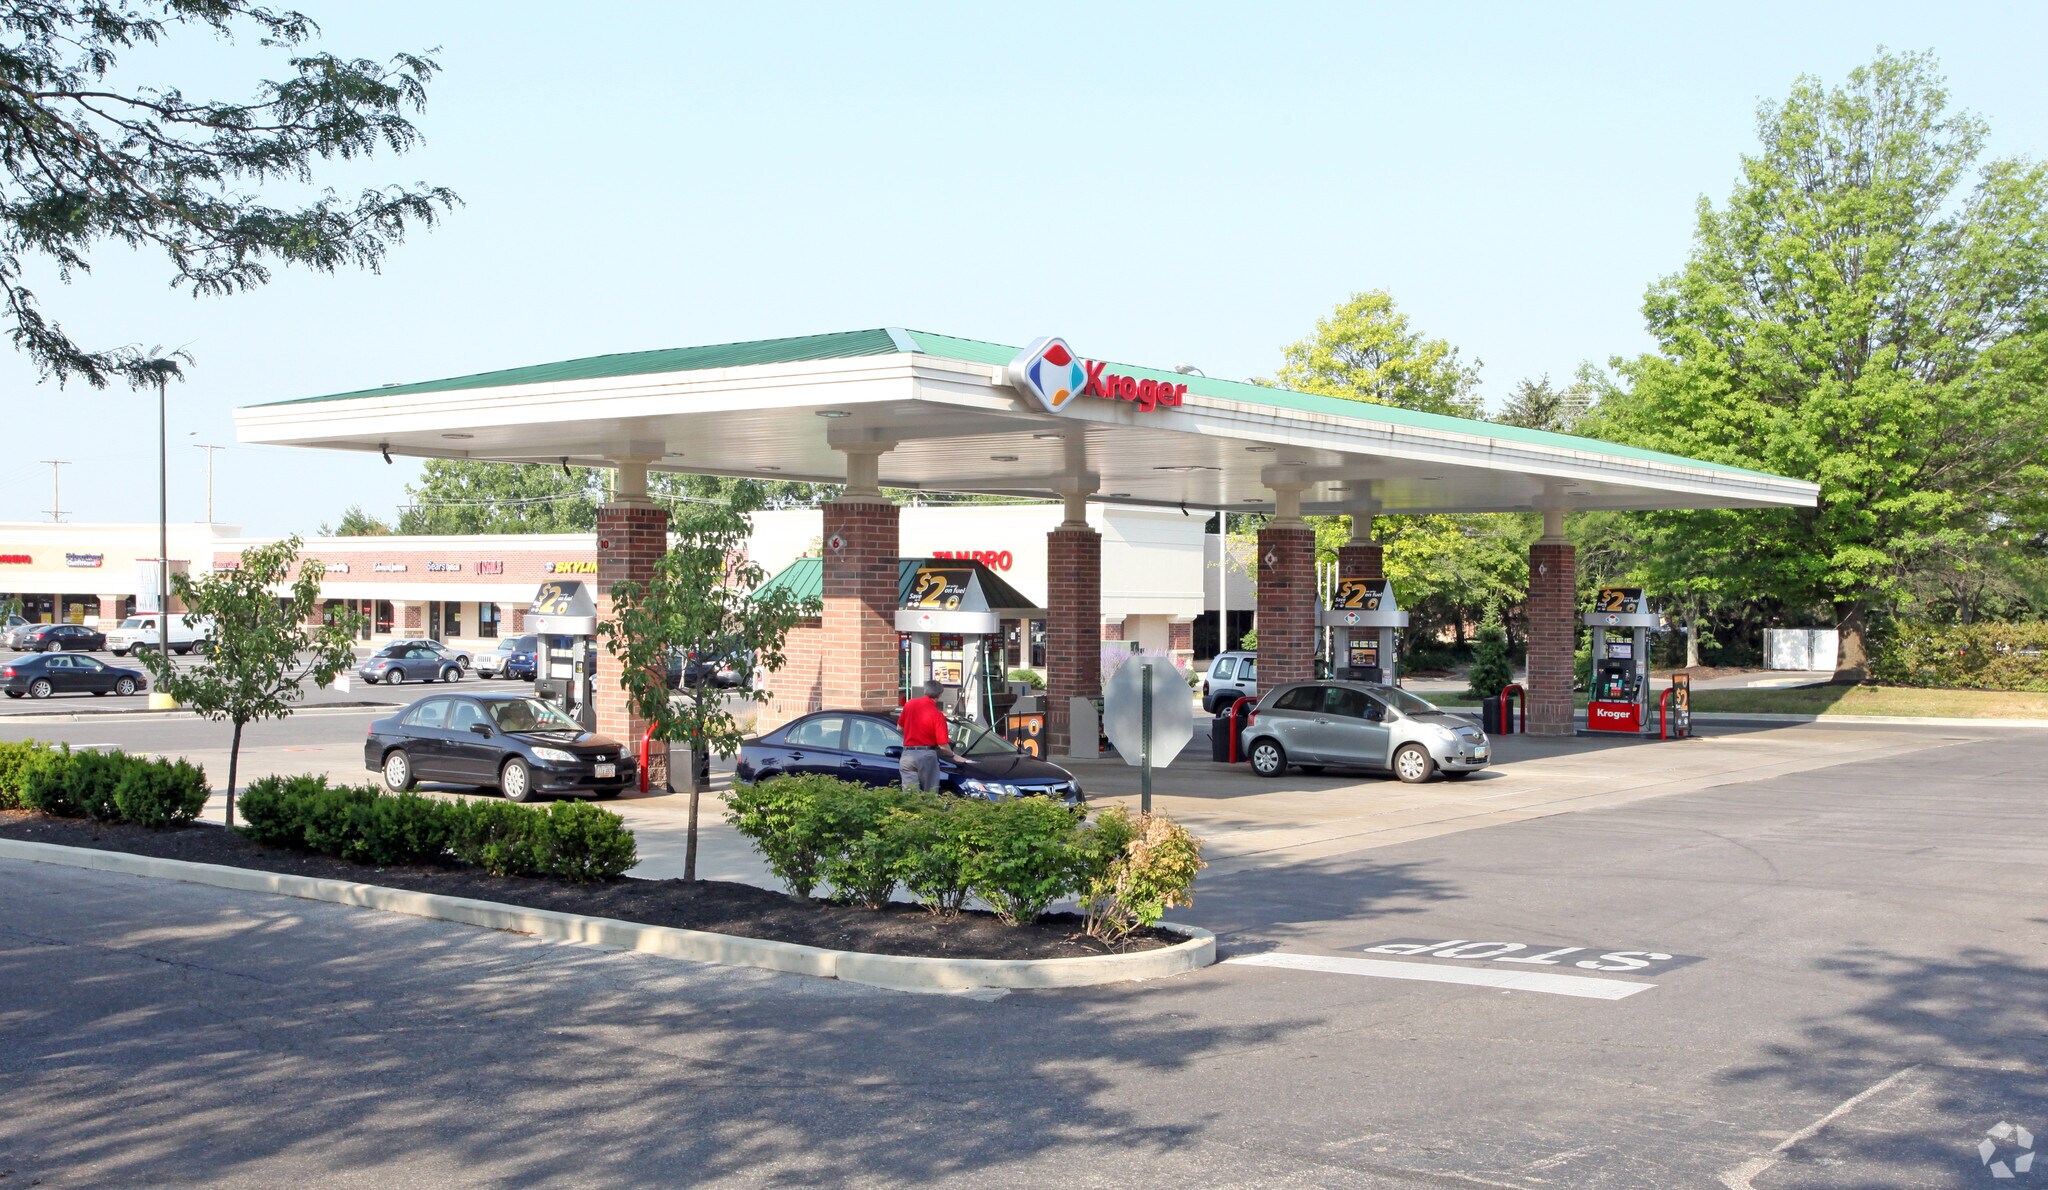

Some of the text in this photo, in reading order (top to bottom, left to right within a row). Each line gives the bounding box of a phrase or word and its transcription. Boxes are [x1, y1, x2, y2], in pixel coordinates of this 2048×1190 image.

[1084, 360, 1187, 412] Kroger
[601, 540, 609, 549] 10
[833, 538, 839, 548] 6
[428, 561, 446, 572] Sears
[555, 561, 598, 573] SKYLIN
[539, 583, 561, 614] $2
[916, 572, 947, 608] $2
[1341, 581, 1367, 608] $2
[1602, 589, 1625, 611] $2
[1677, 688, 1688, 710] $2
[1597, 708, 1630, 719] Kroger
[1364, 940, 1673, 971] STOP
